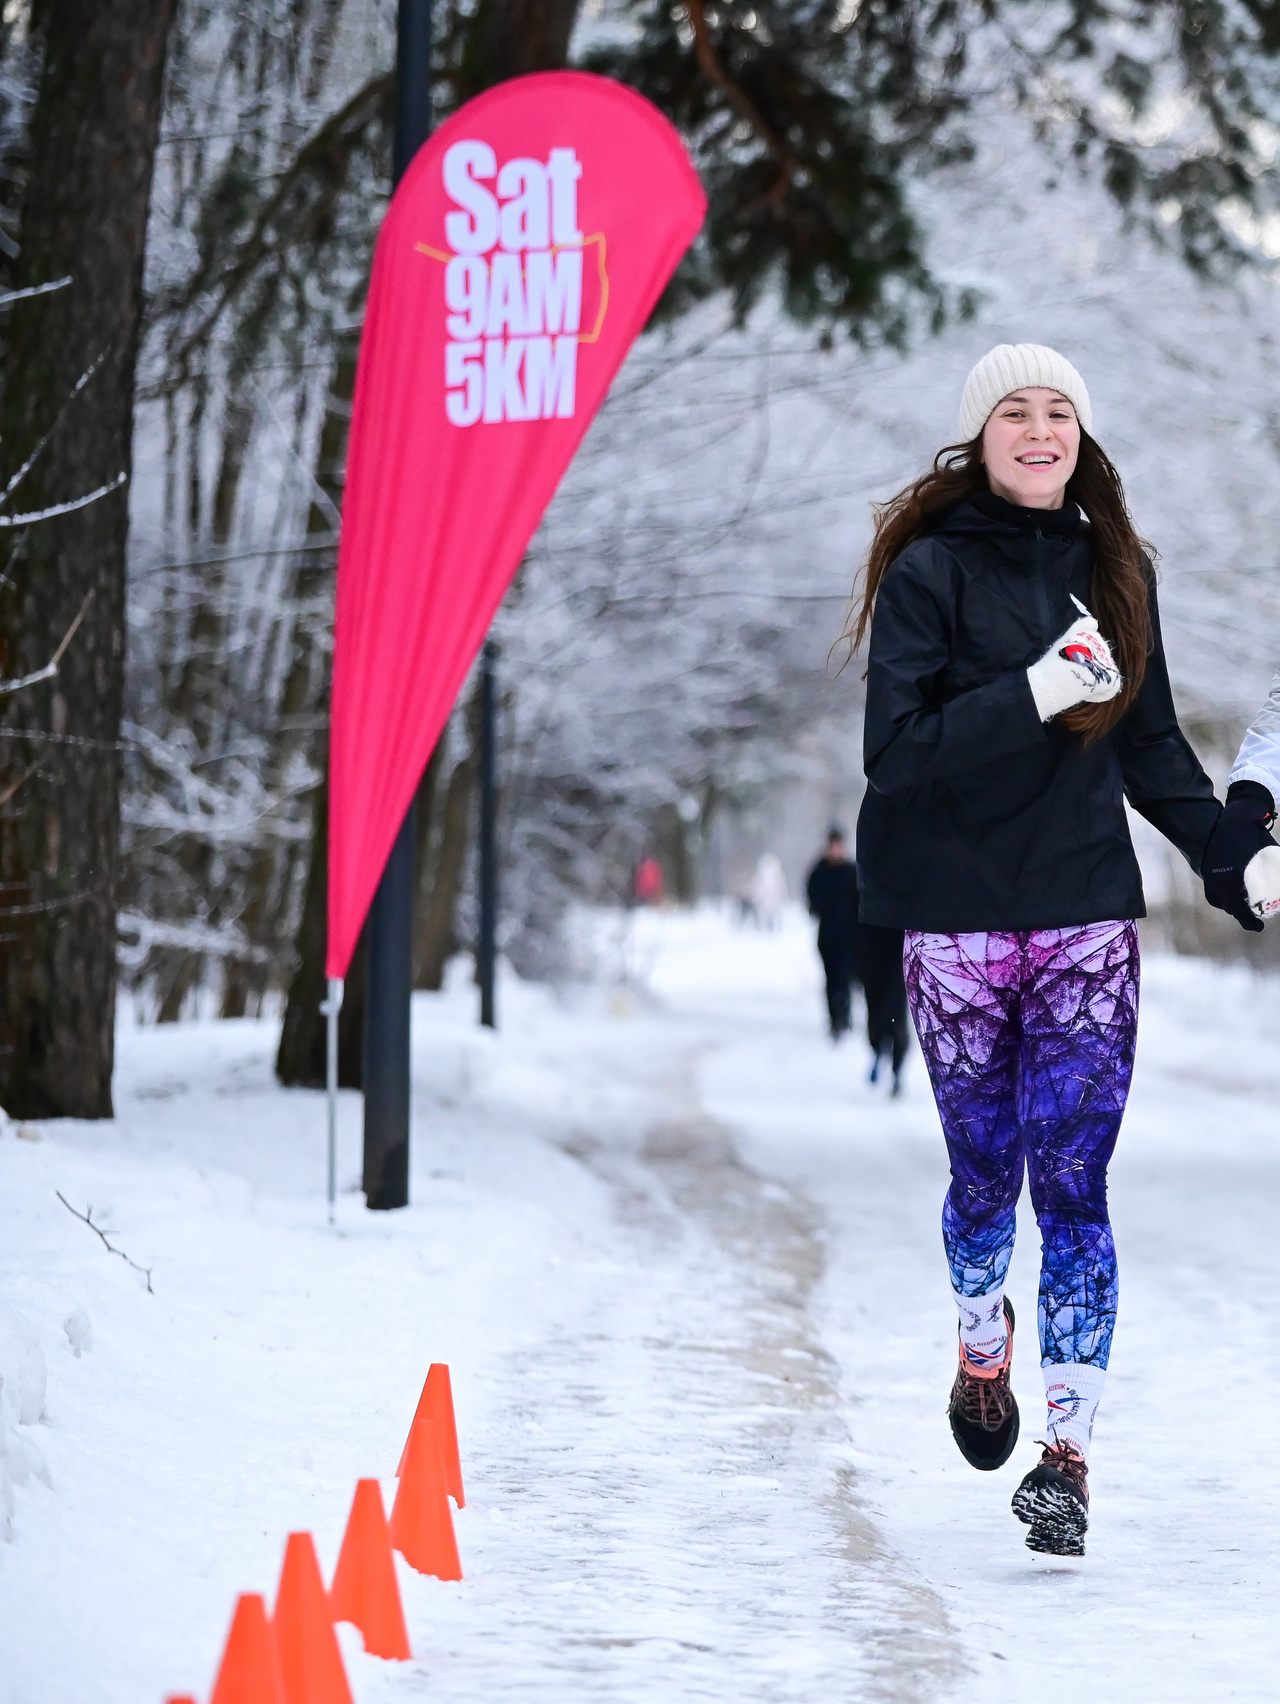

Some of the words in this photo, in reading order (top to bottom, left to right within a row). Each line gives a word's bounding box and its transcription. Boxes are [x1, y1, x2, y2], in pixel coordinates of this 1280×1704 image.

[442, 138, 583, 255] Sat
[444, 250, 583, 340] 9AM
[444, 335, 578, 428] 5KM
